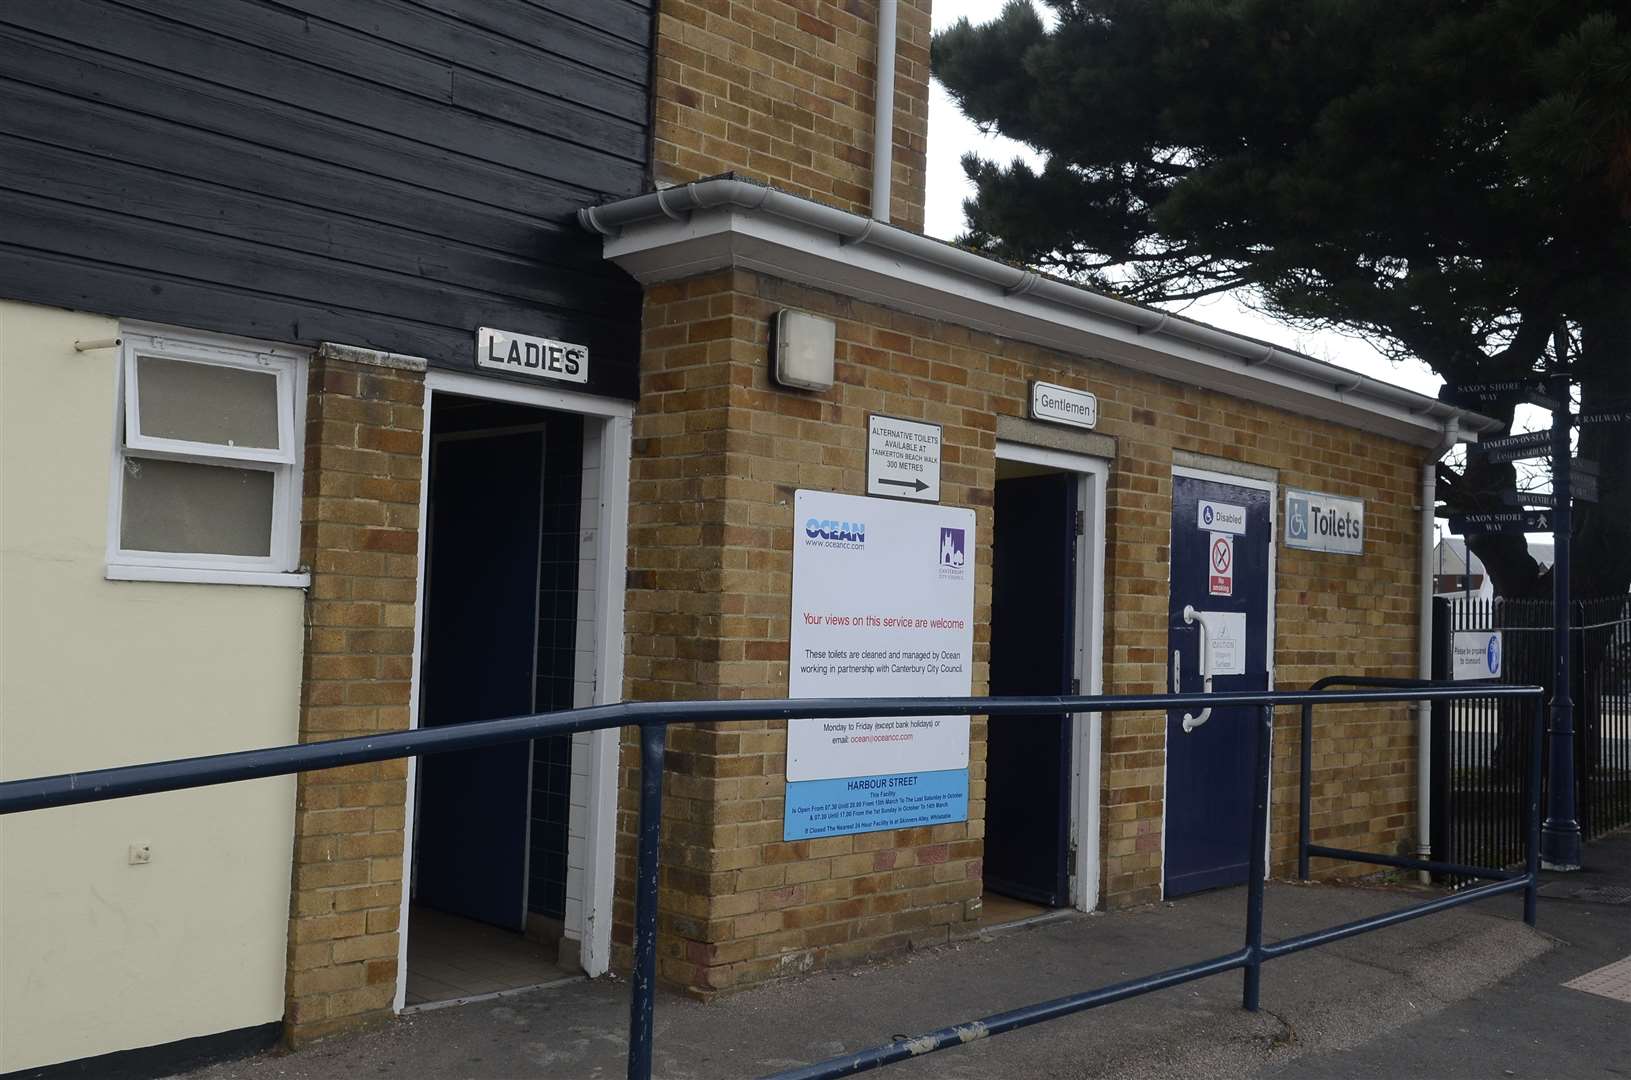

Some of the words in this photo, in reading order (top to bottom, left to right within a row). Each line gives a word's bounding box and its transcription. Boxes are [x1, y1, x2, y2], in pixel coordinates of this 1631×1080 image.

[489, 335, 580, 375] LADIES
[1457, 384, 1486, 393] SAXON
[1490, 382, 1521, 391] SHORE
[1480, 393, 1498, 401] WAY
[1041, 394, 1090, 416] Gentlemen
[1583, 414, 1622, 424] RAILWAY
[872, 427, 913, 440] ALTERNATIVE
[914, 433, 938, 444] TOILETS
[885, 440, 918, 452] AVAILABLE
[872, 449, 903, 459] TANKERTON
[905, 453, 922, 461] BEACH
[887, 460, 897, 468] 300
[899, 463, 924, 472] METRES
[1216, 511, 1242, 525] Disabled
[1311, 506, 1360, 539] Toilets
[806, 518, 864, 542] OCEAN
[1486, 523, 1503, 531] WAY
[806, 540, 864, 551] www.oceancc.com
[804, 612, 822, 624] Your
[825, 613, 849, 625] views
[852, 617, 863, 626] on
[866, 616, 881, 626] this
[883, 616, 912, 627] service
[914, 619, 928, 628] are
[930, 618, 964, 629] welcome
[805, 649, 826, 659] These
[828, 650, 847, 659] toilets
[849, 651, 860, 659] are
[861, 650, 886, 659] cleaned
[888, 650, 901, 659] and
[902, 651, 931, 661] managed
[932, 651, 940, 660] by
[941, 651, 961, 659] Ocean
[800, 664, 828, 675] working
[830, 664, 835, 673] in
[838, 665, 874, 675] partnership
[876, 664, 890, 673] with
[891, 664, 926, 675] Canterbury
[927, 664, 940, 675] City
[823, 723, 847, 733] Monday
[856, 722, 874, 731] Friday
[875, 721, 895, 731] (except
[896, 721, 910, 729] bank
[911, 719, 933, 728] holidays)
[832, 736, 849, 744] email:
[850, 734, 913, 744] ocean@oceancc.com
[847, 778, 887, 791] HARBOUR
[888, 776, 918, 788] STREET
[873, 819, 889, 827] Facility
